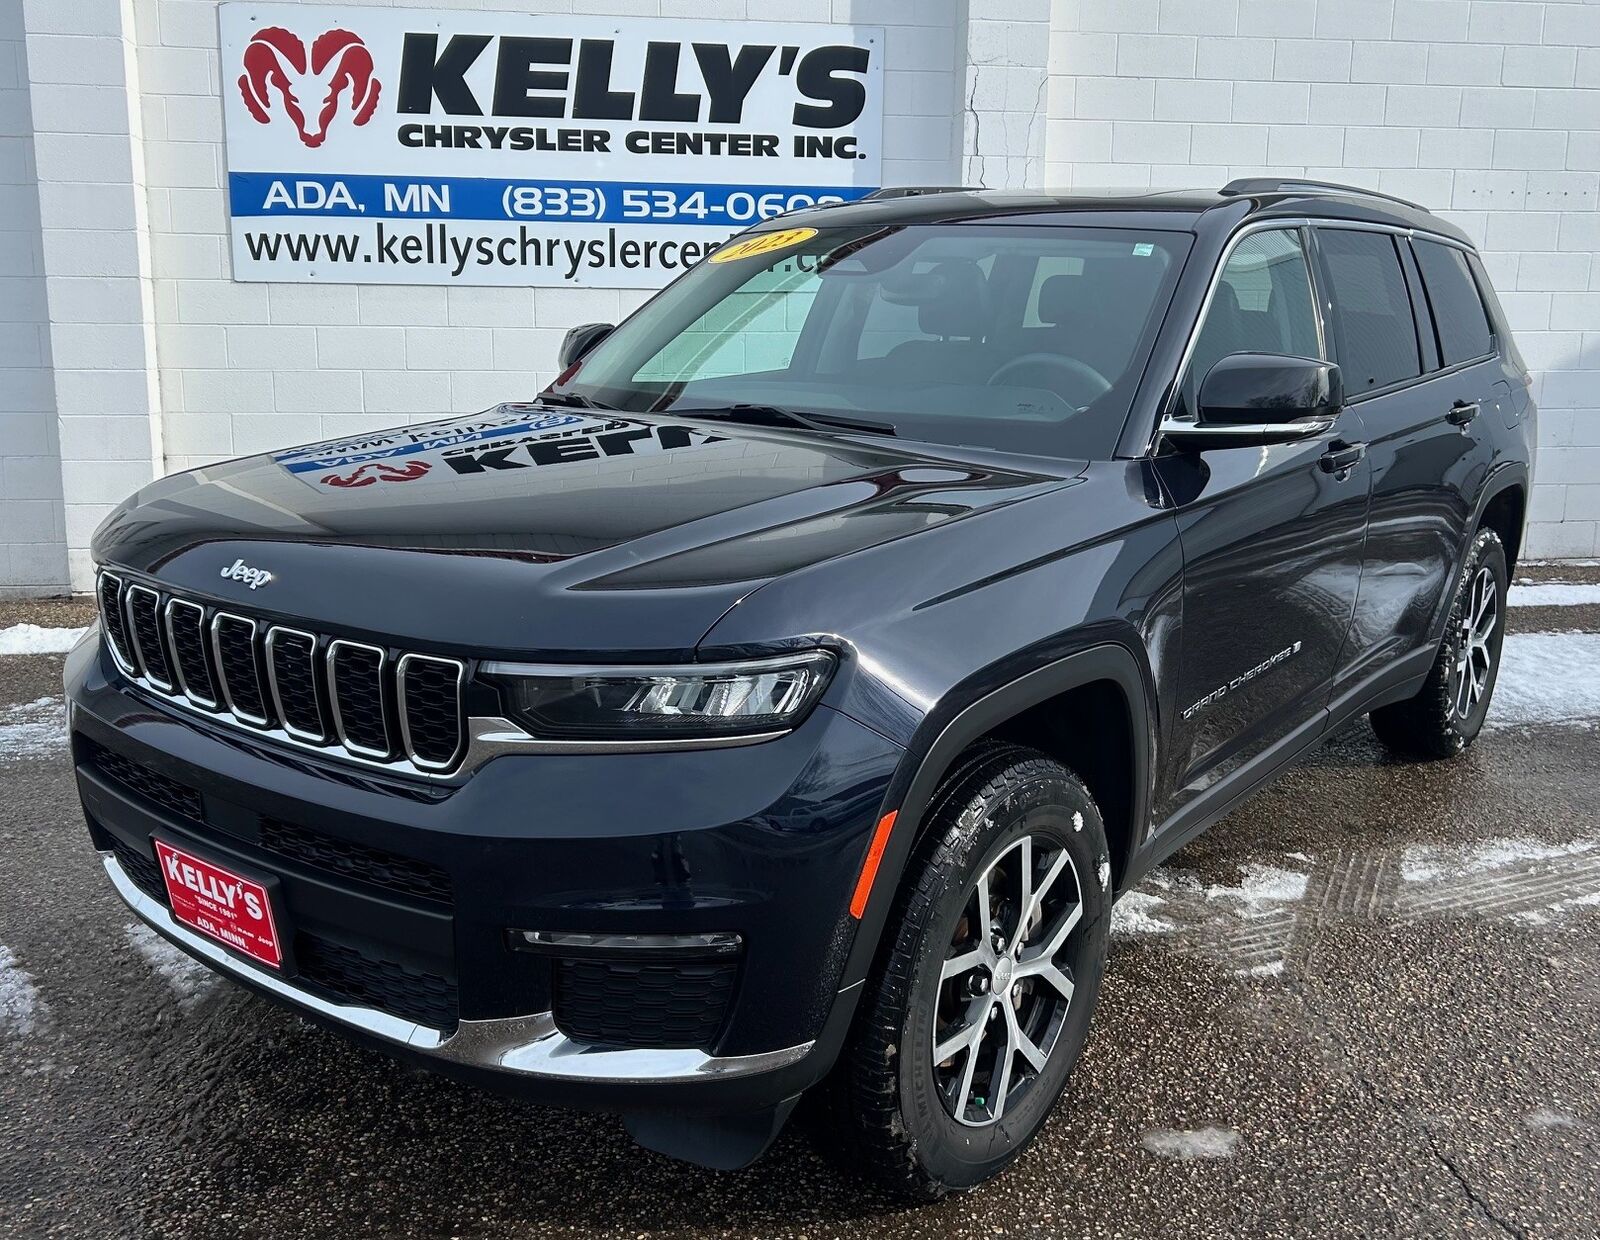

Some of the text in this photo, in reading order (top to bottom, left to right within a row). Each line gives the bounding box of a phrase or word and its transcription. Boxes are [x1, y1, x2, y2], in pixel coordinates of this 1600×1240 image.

[397, 32, 870, 129] KELLY'S
[397, 123, 867, 160] CHRYSLER CENTER INC.
[262, 181, 844, 221] ADA, MN (833) 534-06
[220, 558, 272, 590] Jeep
[1182, 647, 1292, 720] GRAND CHEROKEE
[165, 854, 263, 920] KELLY'S
[197, 916, 219, 936] ADA,
[220, 927, 249, 950] MINN.
